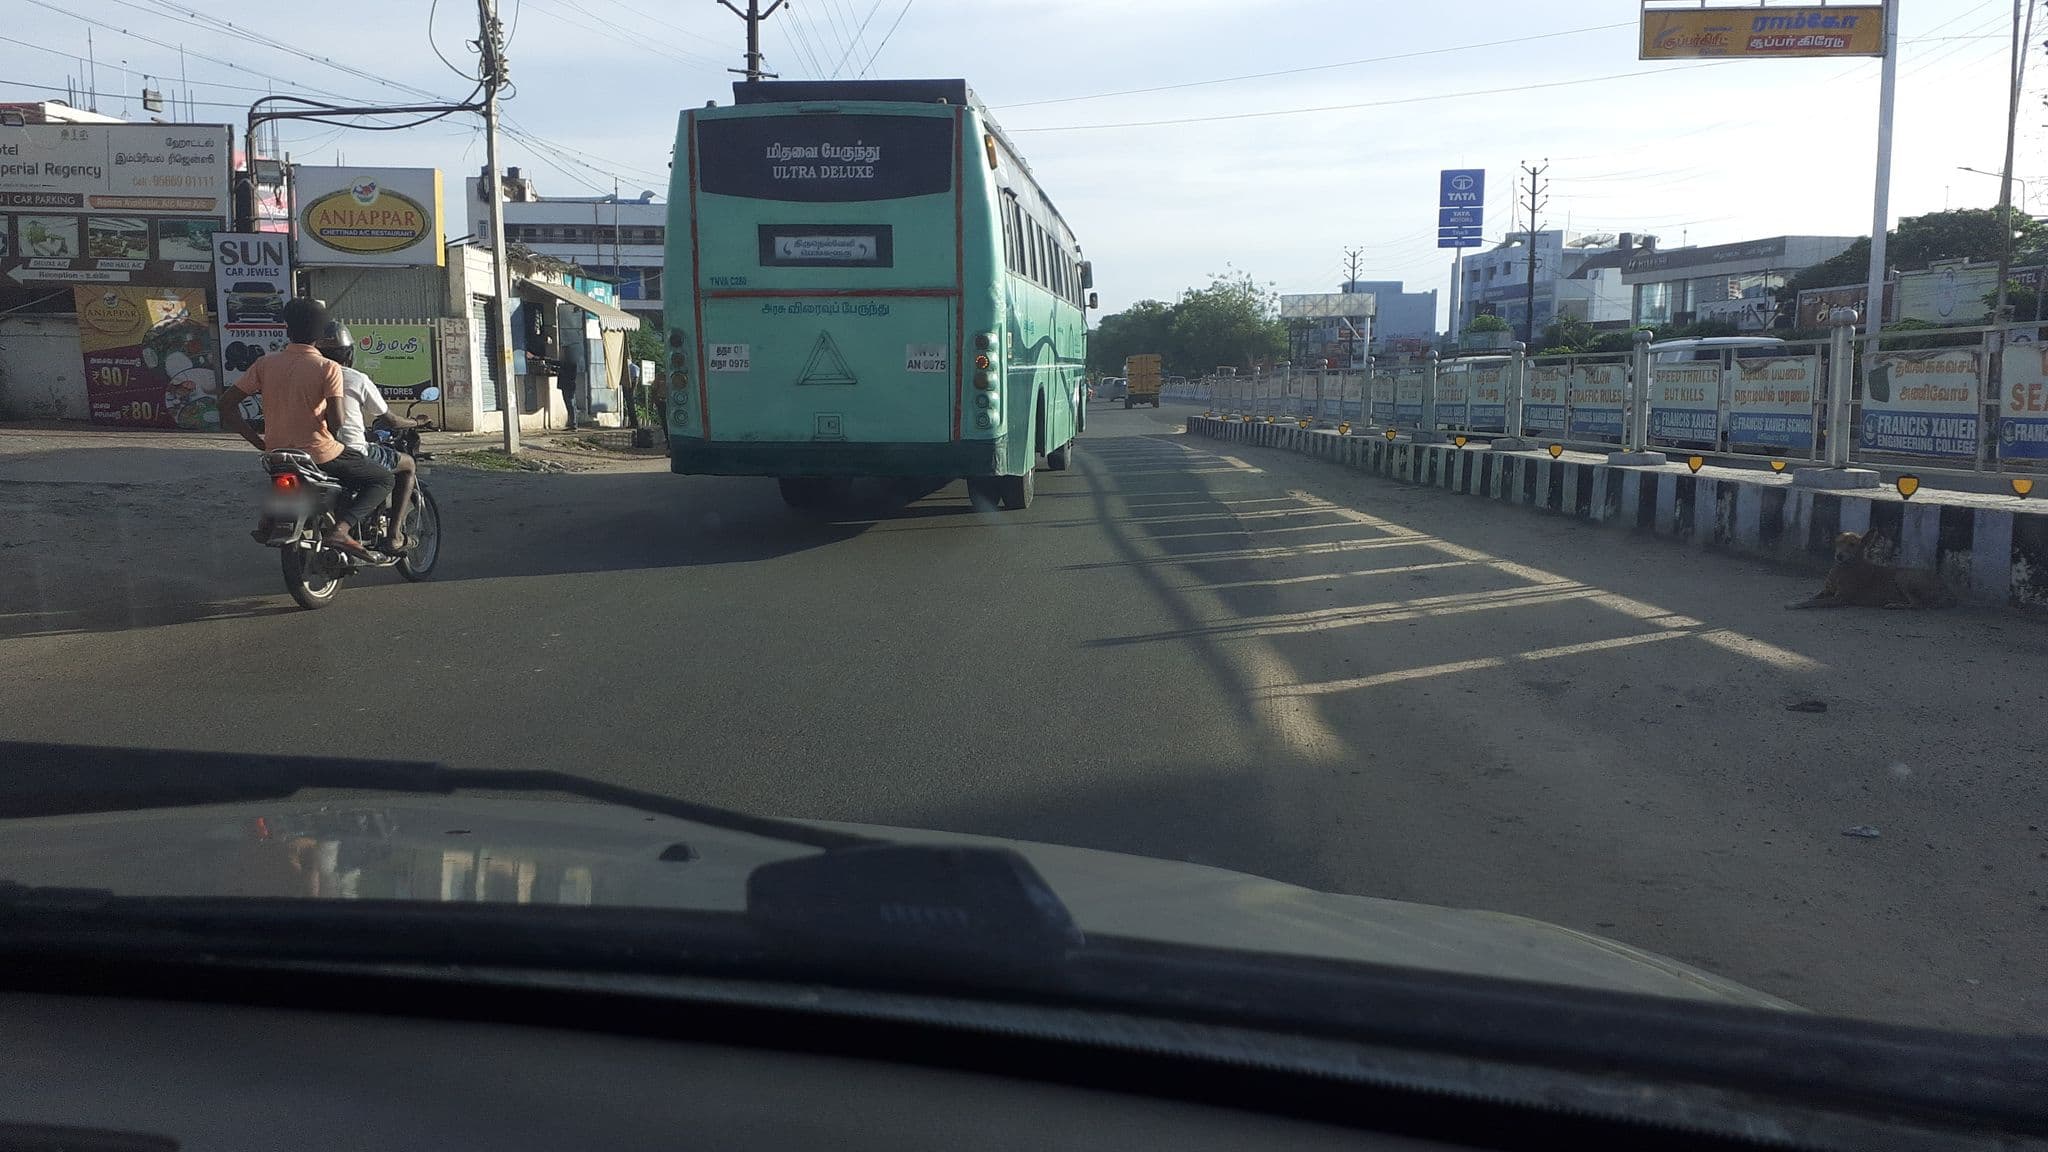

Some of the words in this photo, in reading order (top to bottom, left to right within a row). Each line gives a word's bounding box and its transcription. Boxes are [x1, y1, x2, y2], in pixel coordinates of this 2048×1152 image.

[1752, 11, 1858, 32] ராம்கோ
[1750, 35, 1796, 48] சூப்பர்
[766, 142, 819, 161] மிதவை
[821, 140, 880, 163] பேருந்து
[45, 162, 101, 179] Regency
[772, 166, 817, 179] ULTRA
[820, 166, 874, 178] DELUXE
[14, 195, 33, 204] CAR
[35, 196, 75, 205] PARKING
[1448, 192, 1476, 200] TATA
[319, 209, 416, 227] ANJAPPAR
[220, 240, 283, 266] SUN
[39, 272, 79, 280] Reception
[226, 268, 245, 276] CAR
[247, 268, 279, 276] JEWELS
[762, 303, 786, 315] அரசு
[843, 301, 889, 316] பேருந்து
[258, 330, 284, 338] 31100
[729, 359, 749, 368] 0975
[907, 360, 921, 369] AN
[1656, 369, 1680, 382] SPEED
[1683, 369, 1718, 383] THRILLS
[384, 387, 413, 395] STORES
[1664, 388, 1679, 400] BUT
[1680, 388, 1704, 401] KILLS
[1900, 382, 1969, 401] அணிவோம்
[1691, 412, 1717, 429] XAVIER
[1878, 415, 1929, 437] FRANCIS
[1931, 416, 1977, 439] XAVIER
[1878, 435, 1933, 451] ENGINEERING
[1935, 438, 1976, 454] COLLEGE
